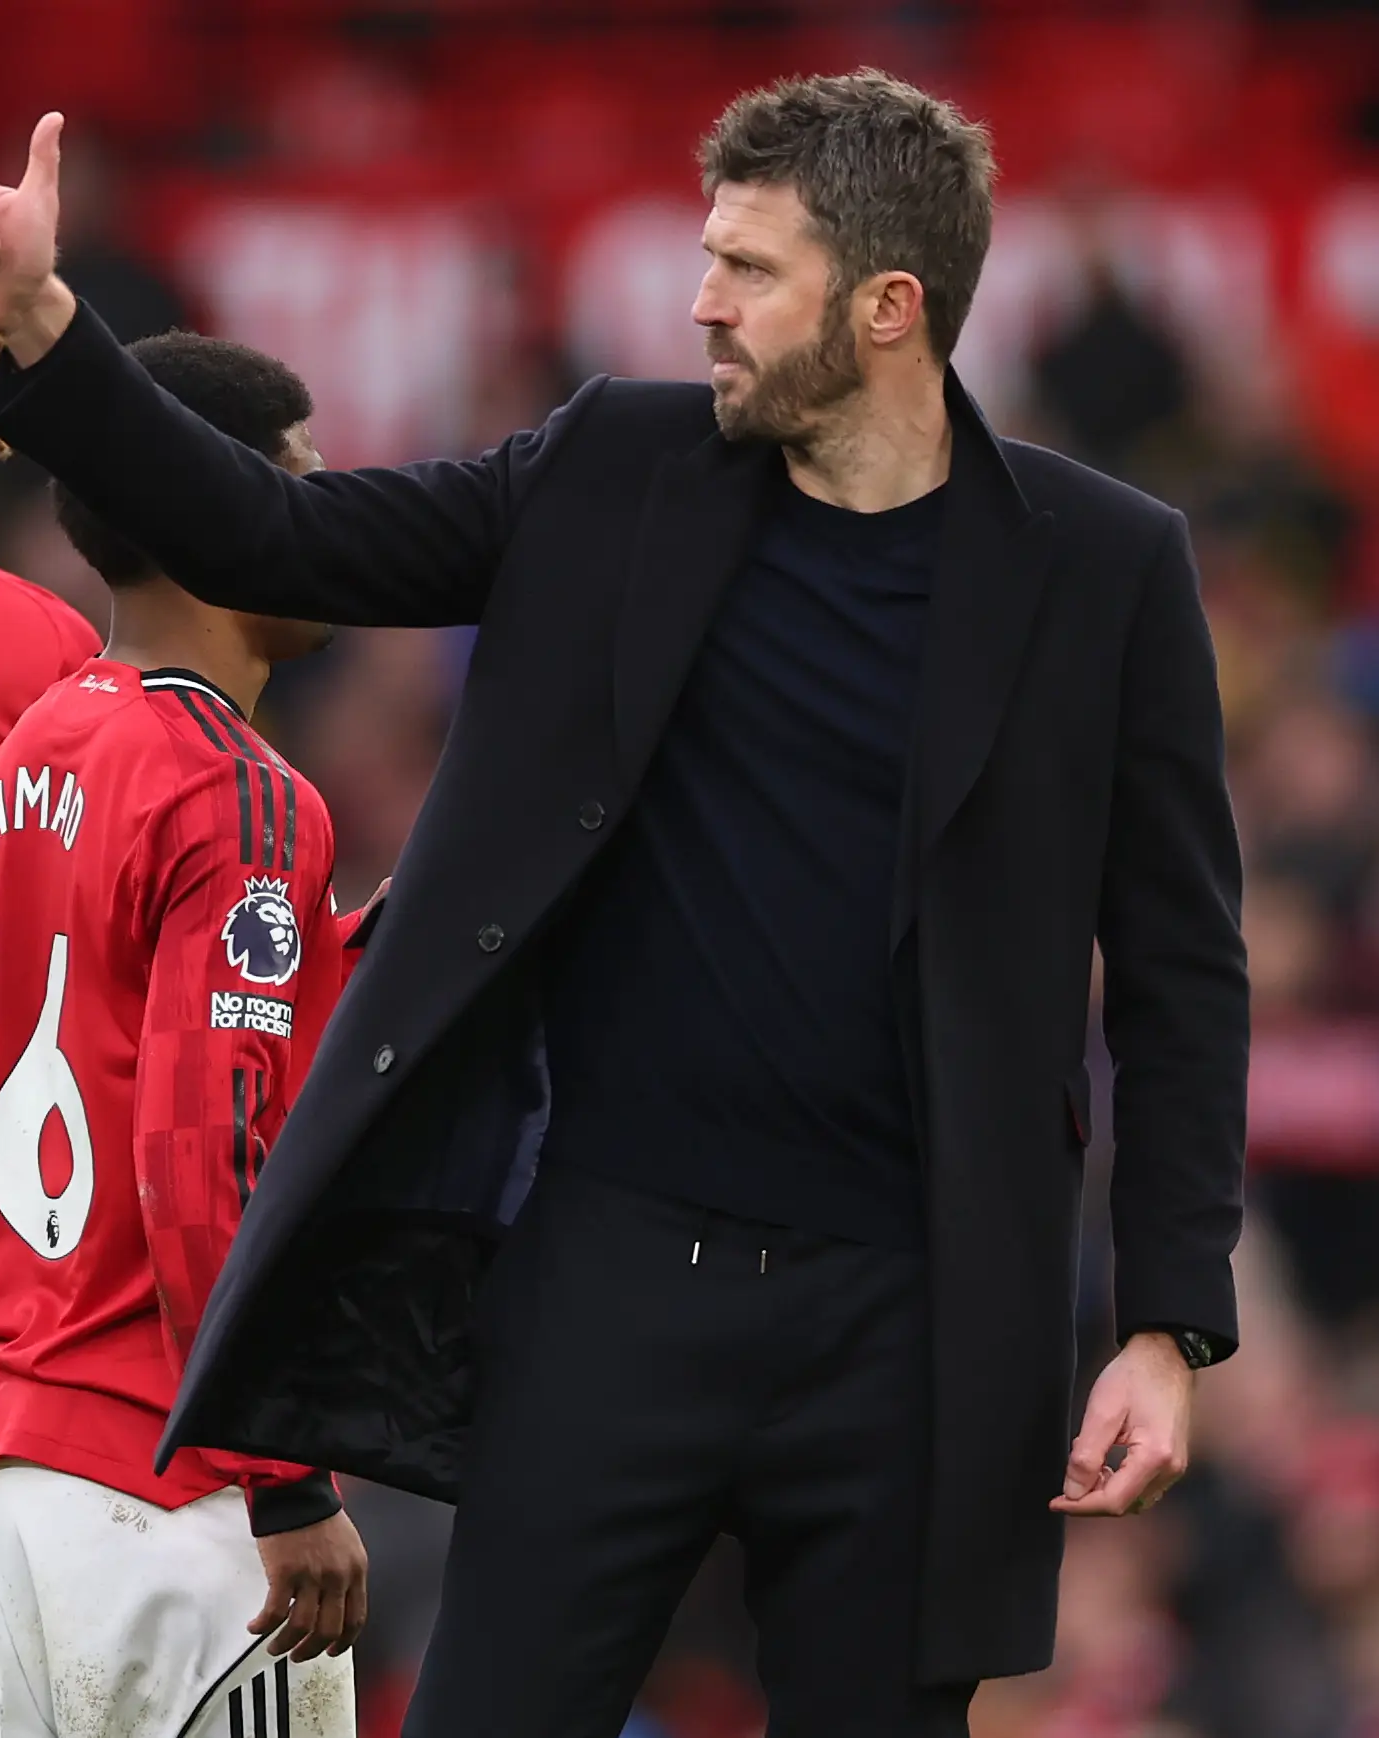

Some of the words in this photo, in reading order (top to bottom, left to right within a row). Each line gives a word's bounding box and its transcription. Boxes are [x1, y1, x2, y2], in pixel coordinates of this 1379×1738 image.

[211, 991, 244, 1012] No
[246, 997, 292, 1022] room
[211, 1010, 242, 1028] for
